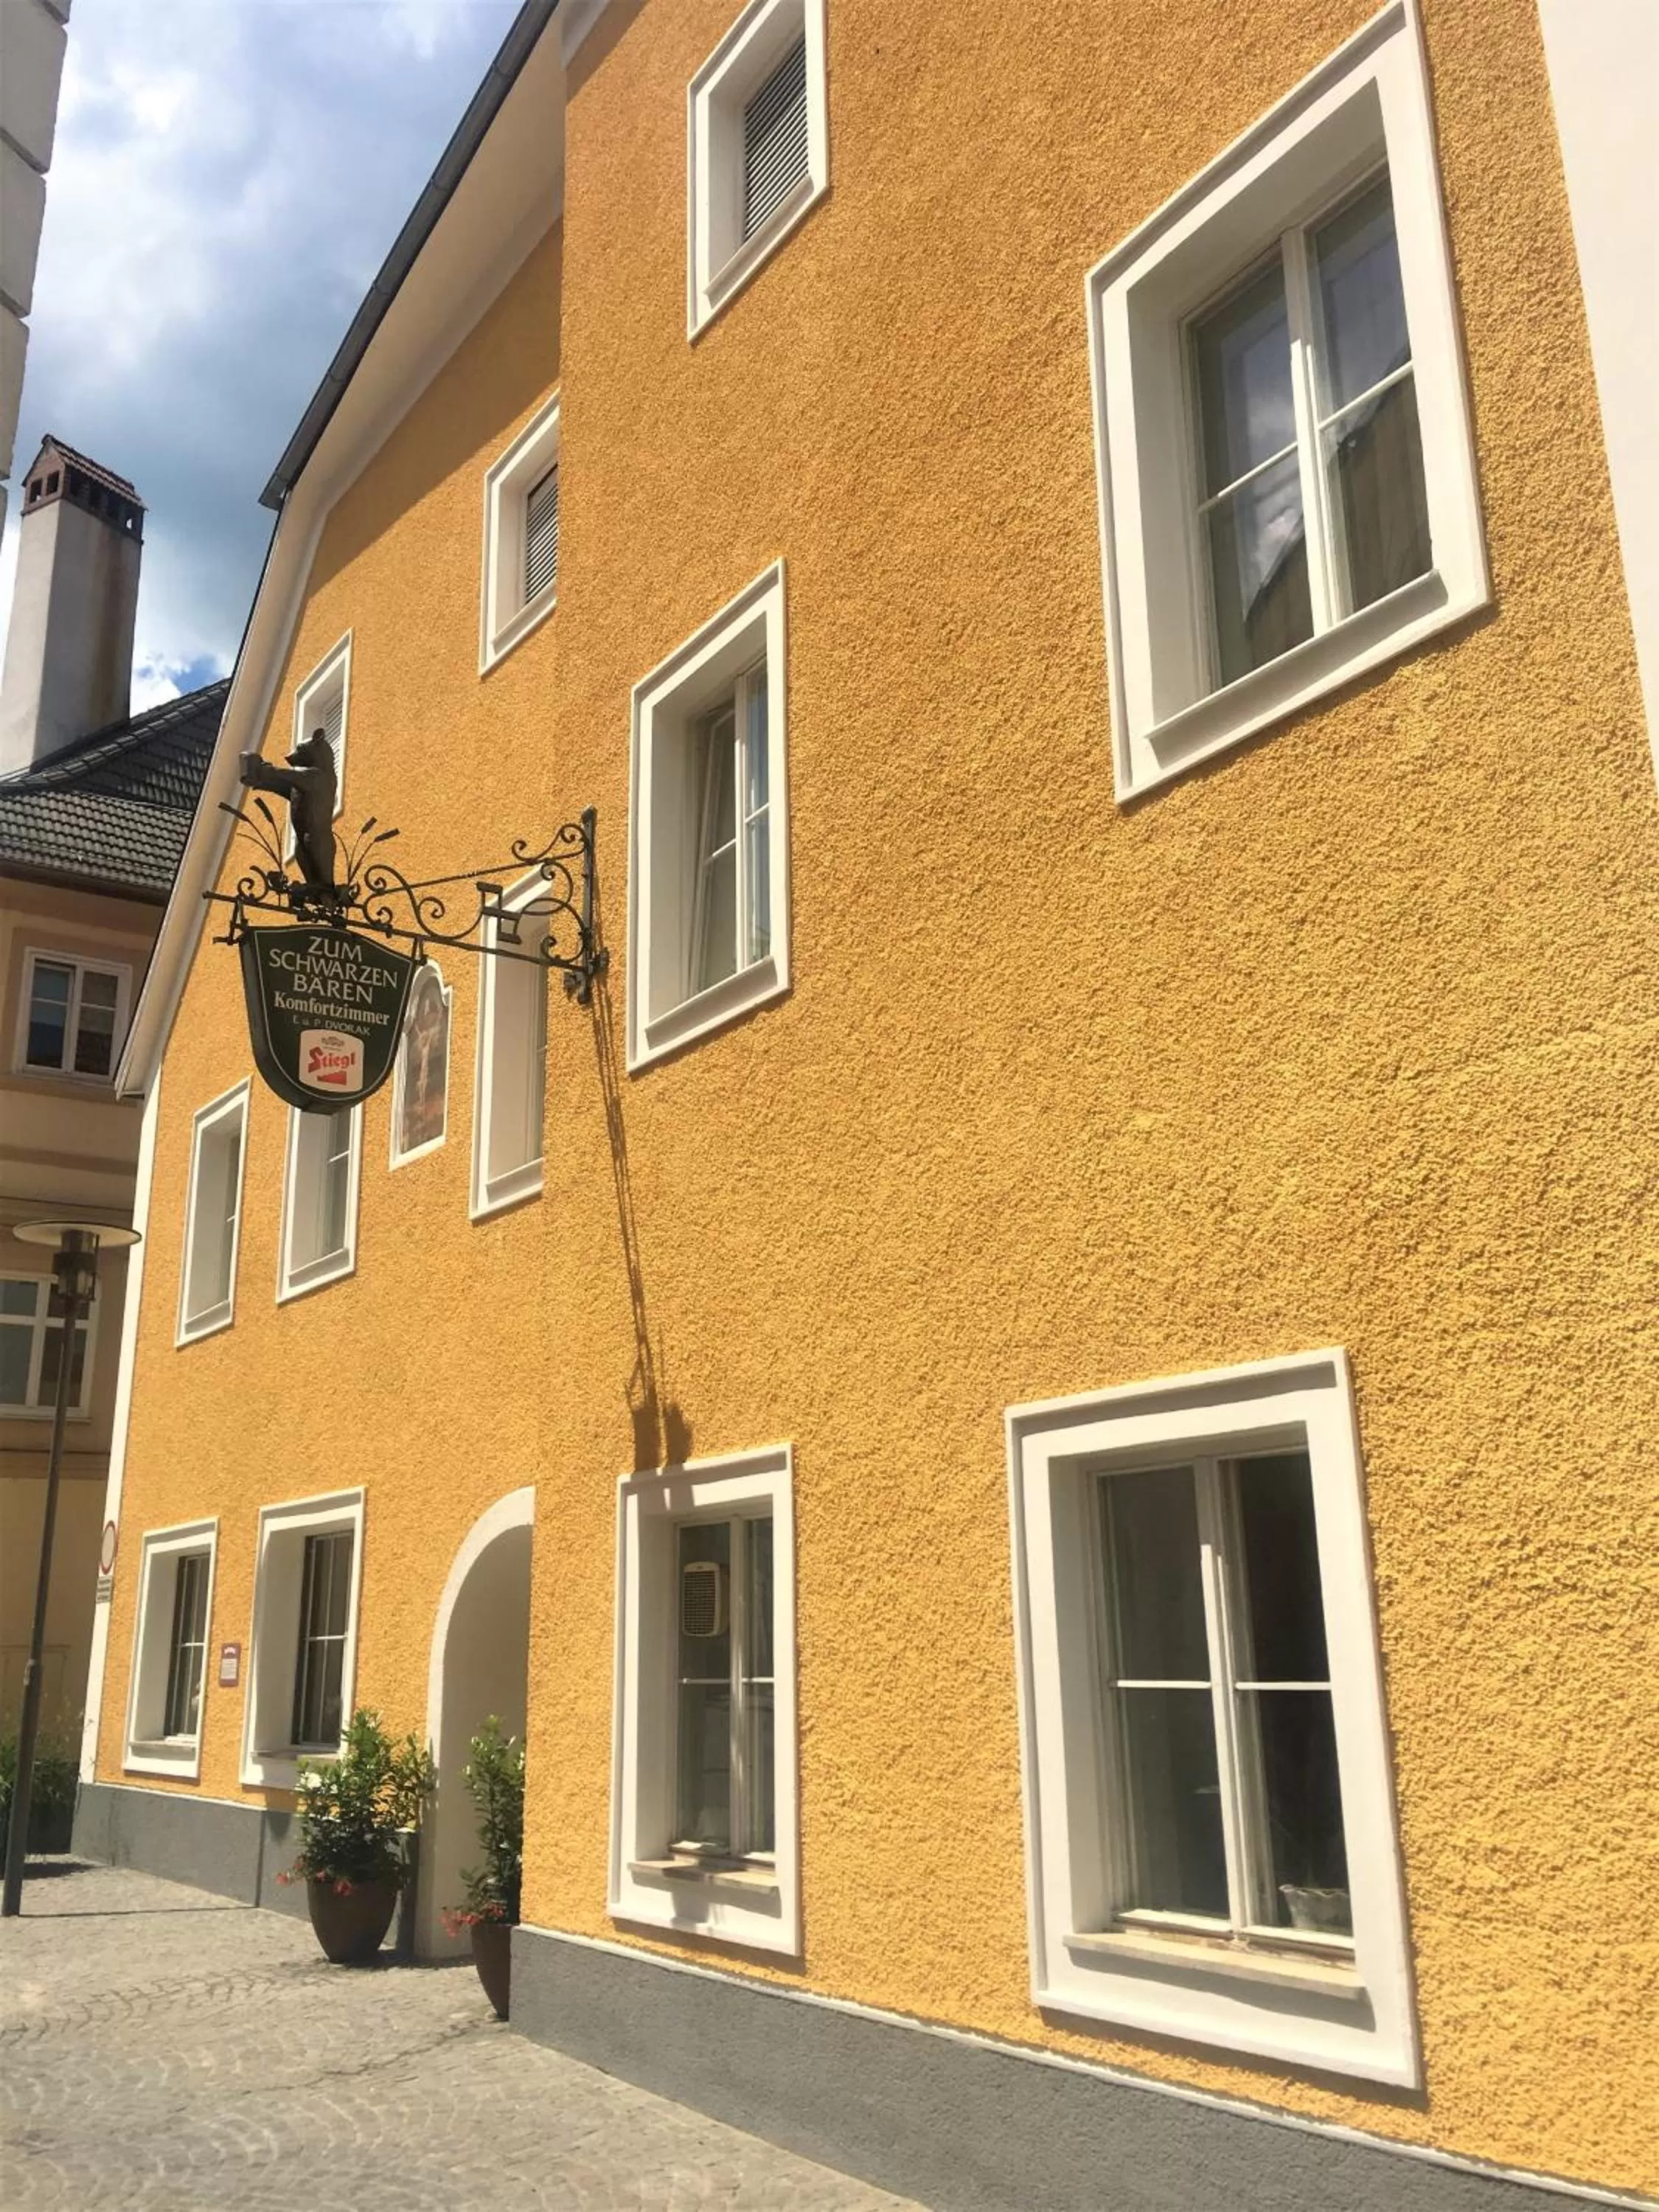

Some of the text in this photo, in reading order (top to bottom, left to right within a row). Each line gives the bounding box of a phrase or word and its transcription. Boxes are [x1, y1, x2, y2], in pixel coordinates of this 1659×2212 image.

[307, 936, 362, 962] ZUM
[269, 948, 398, 989] SCHWARZEN
[293, 973, 373, 1004] BÄREN
[274, 990, 390, 1026] Komfortzimmer
[307, 1046, 355, 1074] Stiegl
